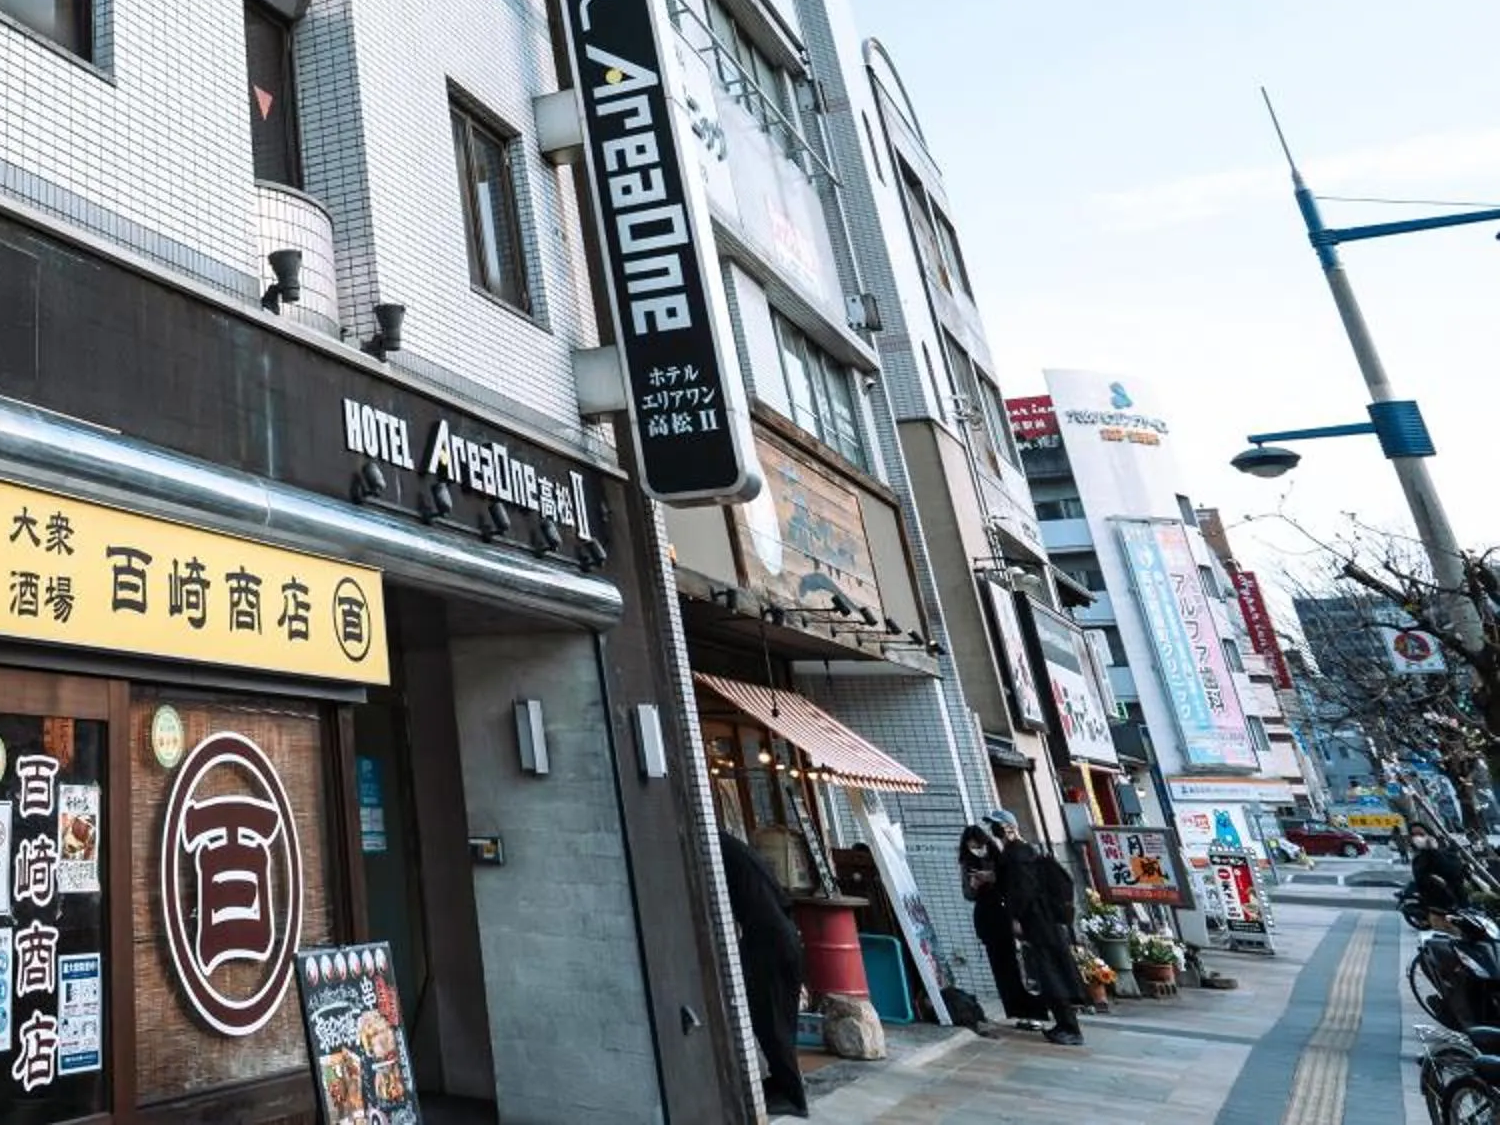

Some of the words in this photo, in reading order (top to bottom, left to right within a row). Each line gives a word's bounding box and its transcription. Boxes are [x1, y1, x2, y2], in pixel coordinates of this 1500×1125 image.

[585, 43, 692, 336] AreaOne
[642, 386, 715, 410] エリアワン
[649, 364, 699, 386] ホテル
[343, 398, 414, 470] HOTEL
[9, 507, 75, 555] 大衆
[9, 570, 75, 623] 酒場
[105, 545, 312, 642] 百崎商店
[12, 754, 60, 1092] 百崎商店
